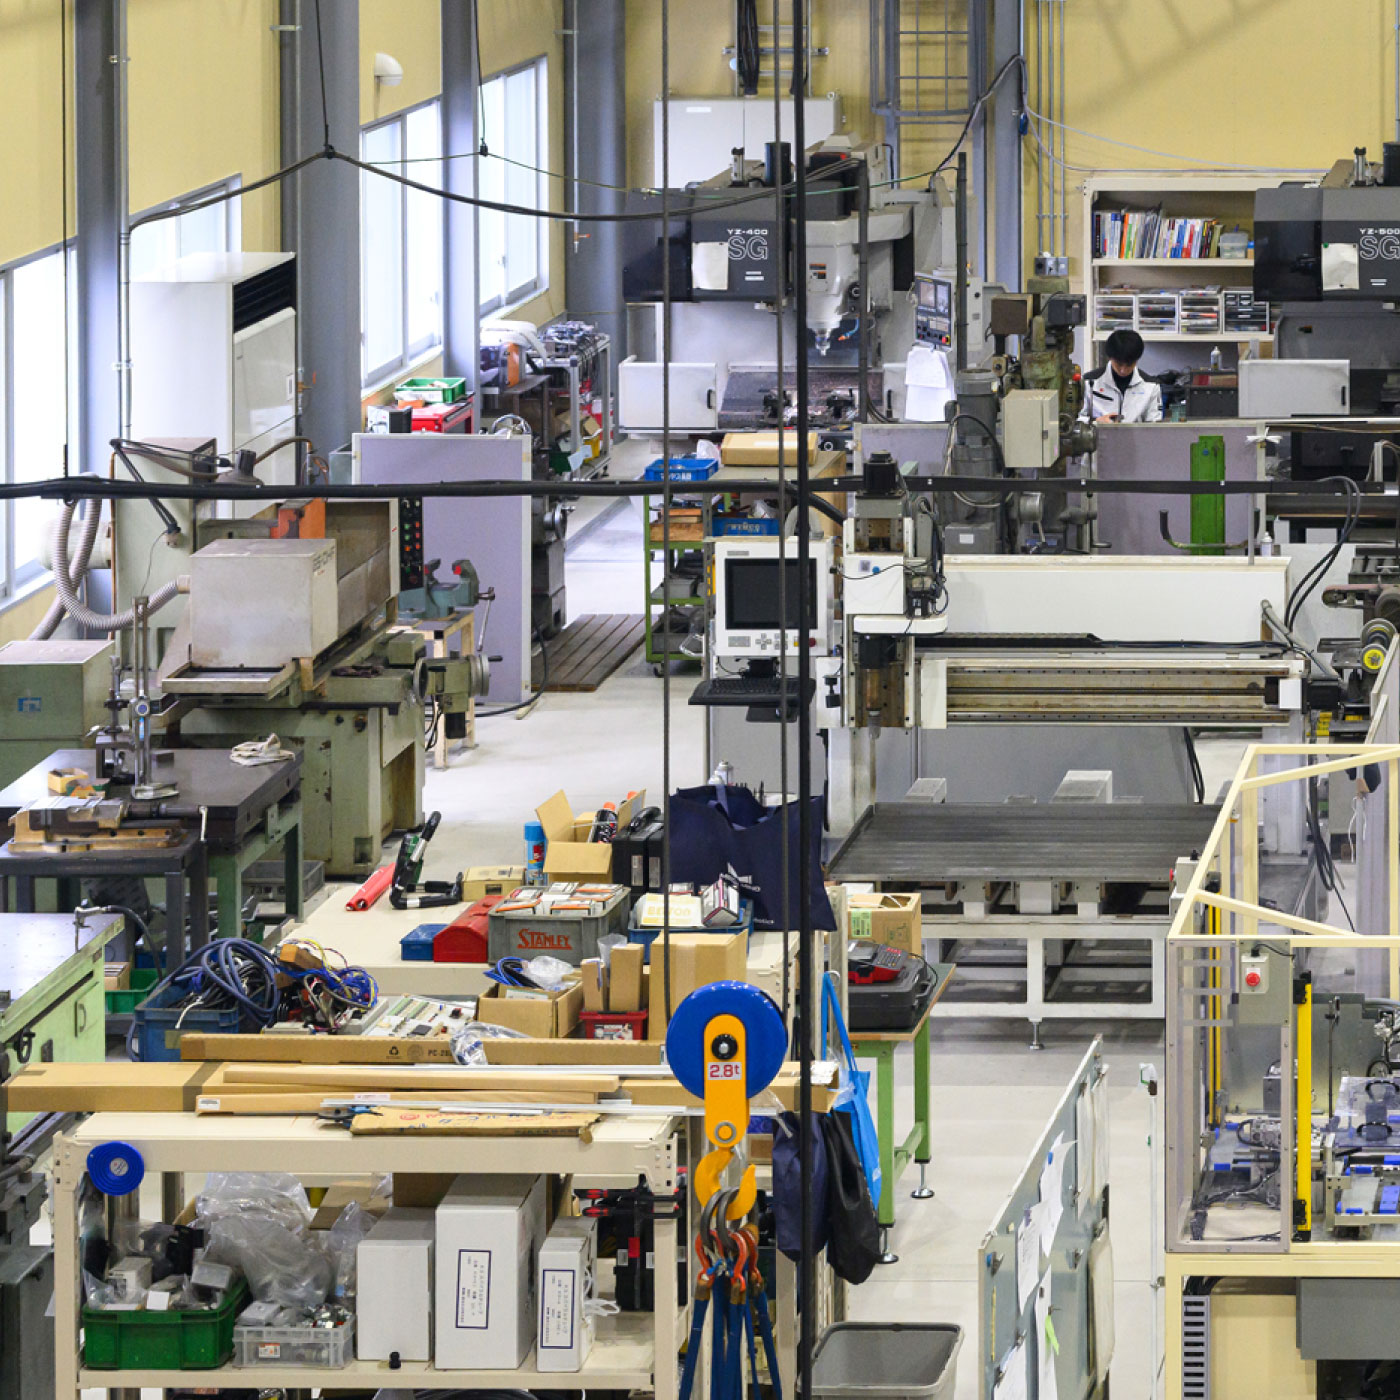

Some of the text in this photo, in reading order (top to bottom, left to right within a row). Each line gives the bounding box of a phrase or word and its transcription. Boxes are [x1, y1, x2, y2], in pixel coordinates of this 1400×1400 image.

[728, 235, 768, 260] SG
[517, 928, 572, 950] STANLEY
[709, 1064, 740, 1078] 2.8t
